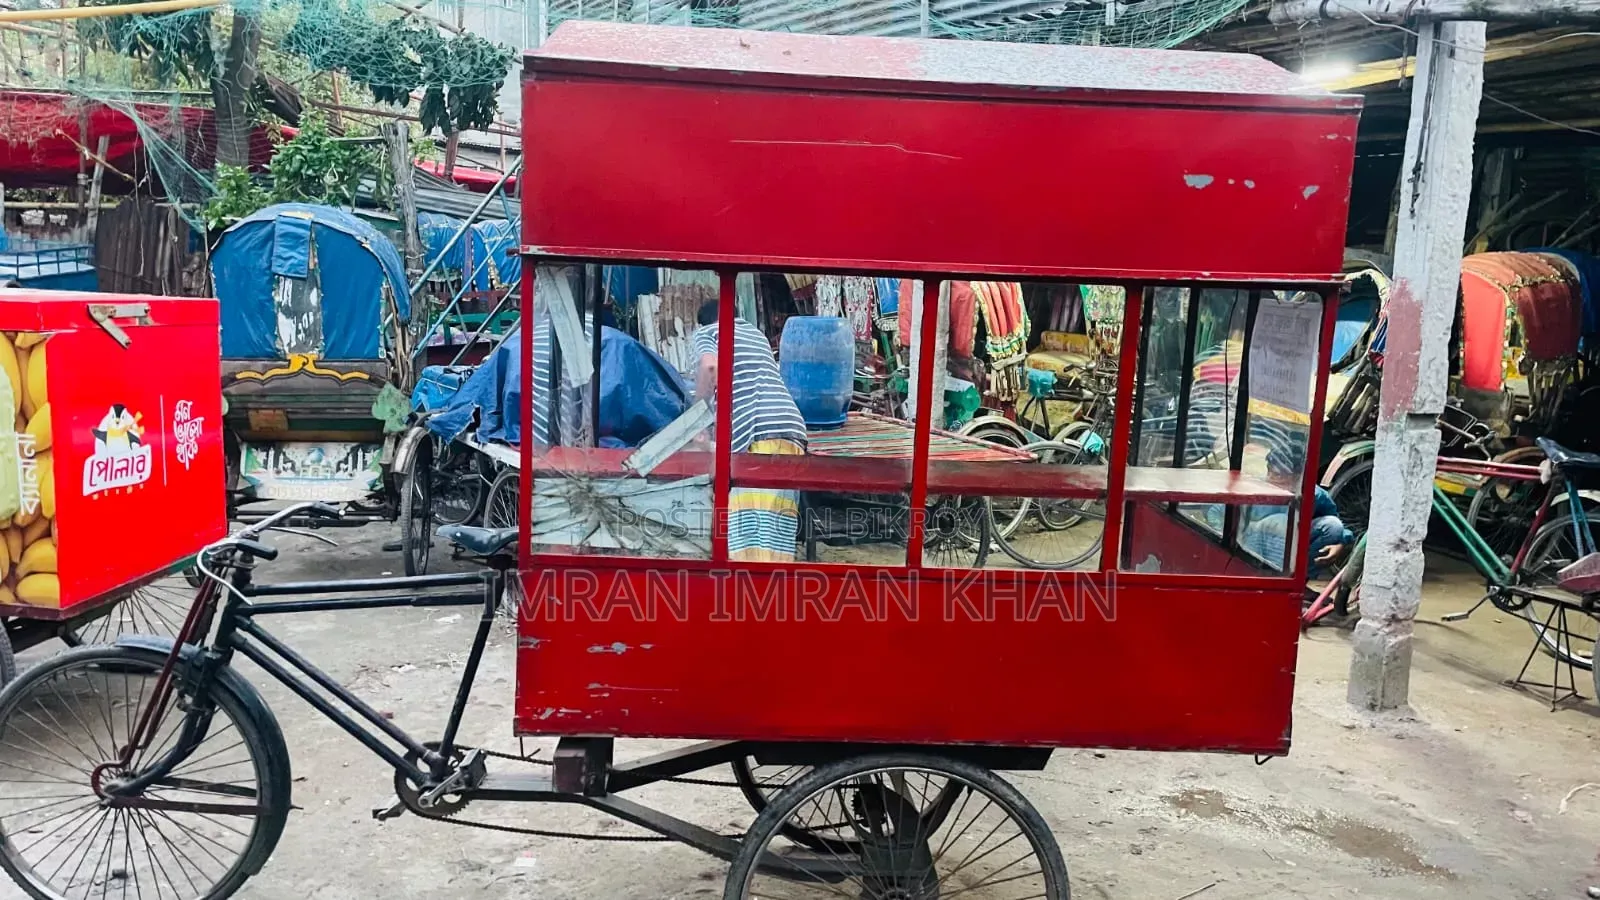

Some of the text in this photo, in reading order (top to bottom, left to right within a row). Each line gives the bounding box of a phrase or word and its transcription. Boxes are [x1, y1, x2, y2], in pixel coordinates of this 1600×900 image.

[174, 399, 193, 422] মন
[173, 416, 205, 443] ভালো
[89, 454, 146, 487] পোলার
